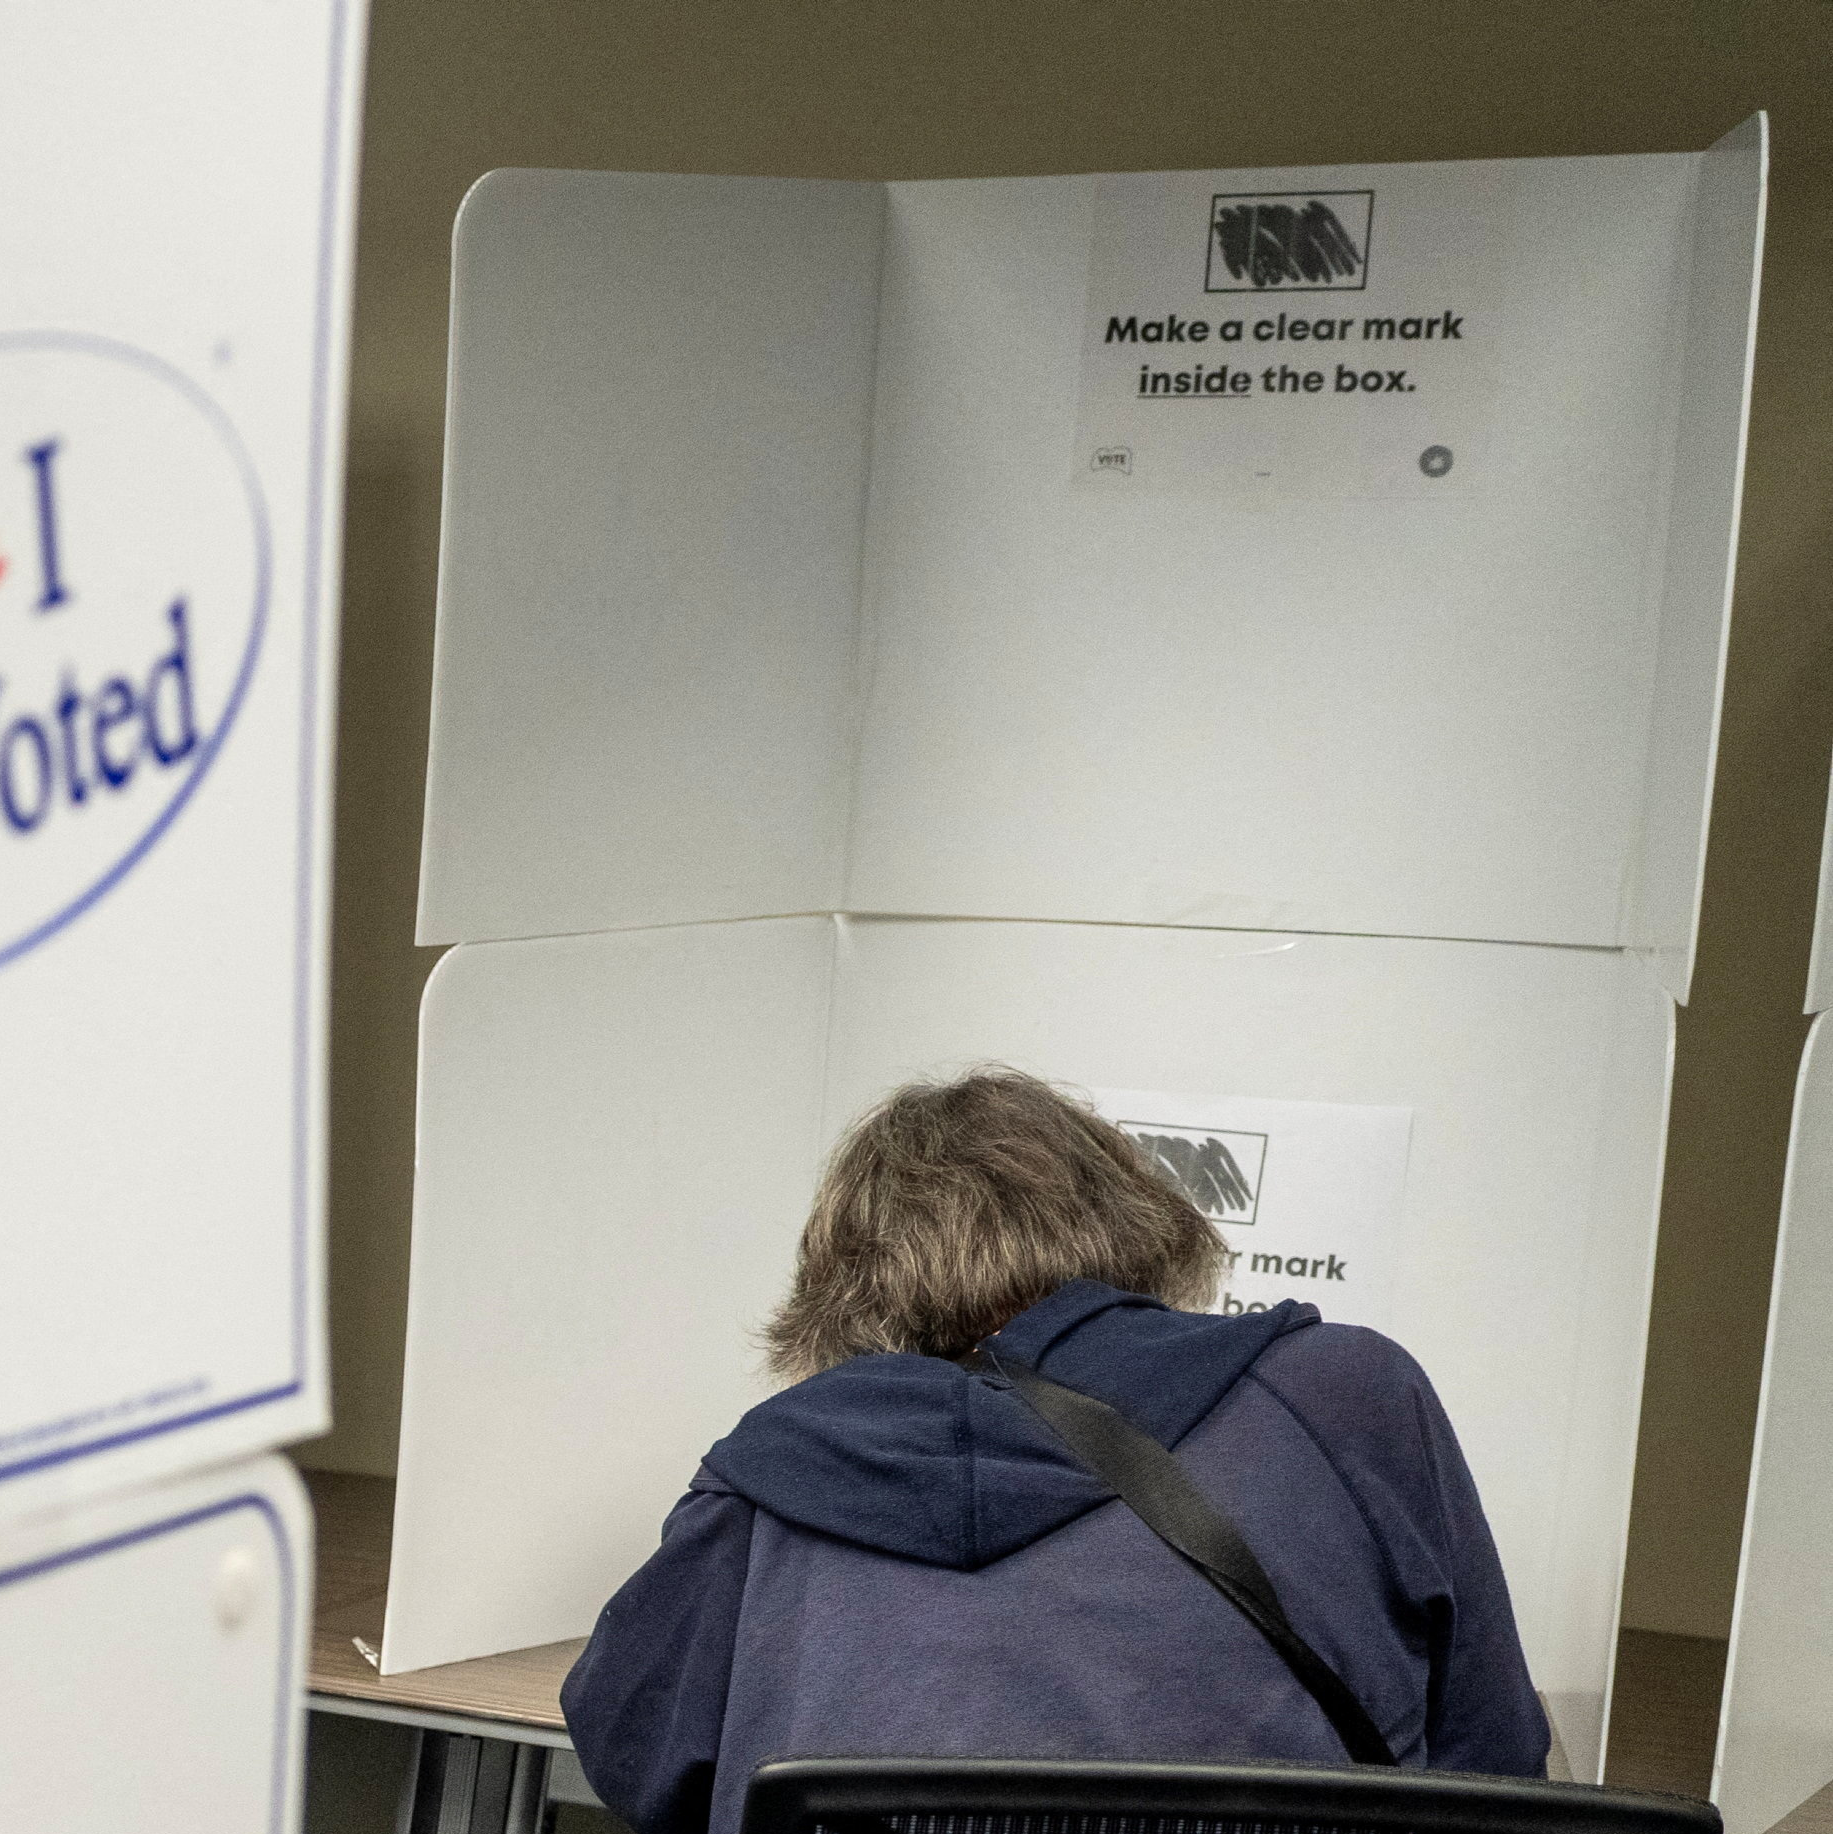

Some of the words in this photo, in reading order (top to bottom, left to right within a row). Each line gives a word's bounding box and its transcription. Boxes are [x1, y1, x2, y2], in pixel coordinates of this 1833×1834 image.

[1105, 315, 1210, 343] Make
[1220, 320, 1243, 341] a
[1253, 313, 1354, 341] clear
[1363, 311, 1464, 339] mark
[1138, 364, 1252, 394] inside
[1262, 364, 1325, 393] the
[1335, 364, 1417, 392] box.
[21, 434, 73, 616] I
[1251, 1253, 1347, 1281] mark
